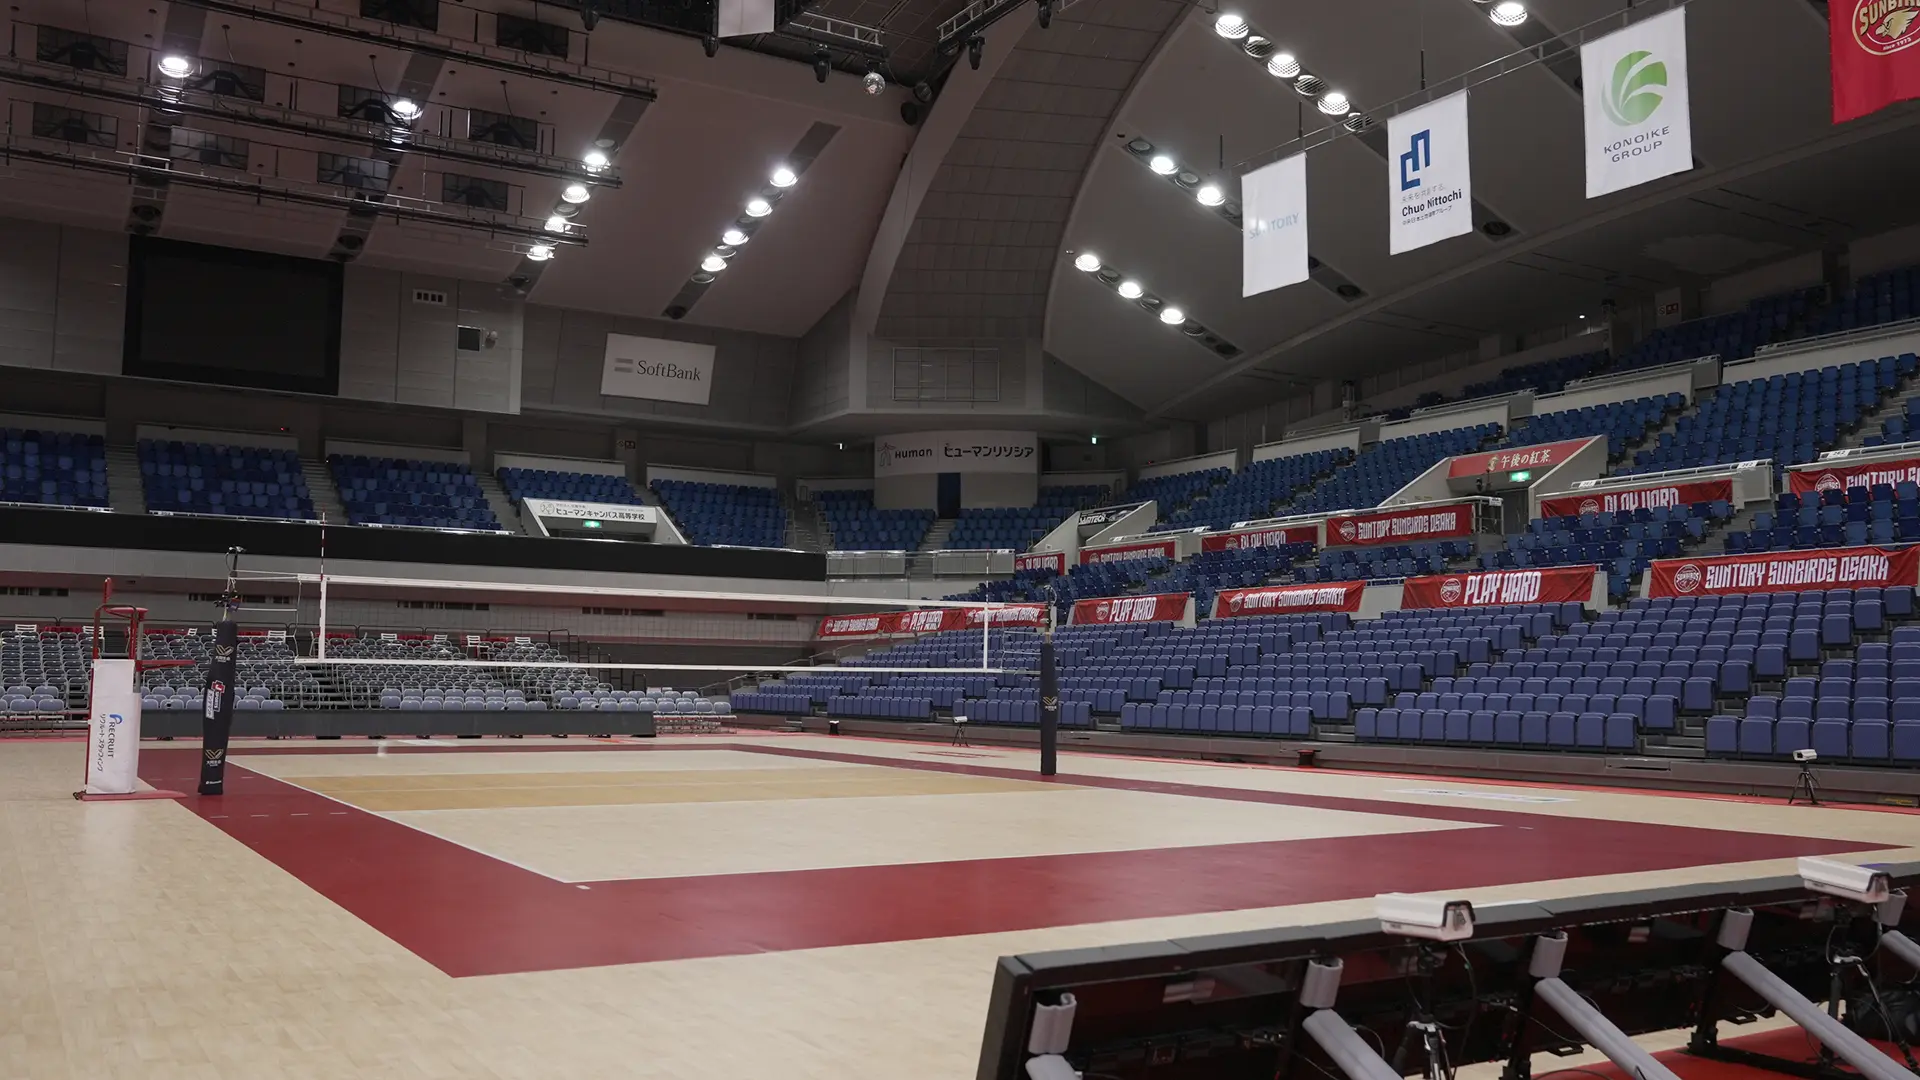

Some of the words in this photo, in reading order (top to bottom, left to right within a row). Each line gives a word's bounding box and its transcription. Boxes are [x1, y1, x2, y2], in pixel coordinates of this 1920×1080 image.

[1604, 126, 1670, 153] KONOIKE
[1611, 141, 1663, 162] GROUP
[1402, 203, 1425, 217] Chuo
[1427, 188, 1462, 209] Nittochi
[637, 360, 701, 381] SoftBank
[944, 446, 1035, 458] ヒューマンリソシア
[1501, 449, 1551, 469] 午後の紅茶
[556, 507, 645, 520] ヒューマンキャンパス高等学校
[1358, 519, 1391, 539] SUNTORY
[1392, 515, 1429, 536] SUNBIRDS
[1430, 512, 1456, 532] OSAKA
[1705, 561, 1767, 589] SUNTORY
[1767, 557, 1837, 586] SUNBIRDS
[1839, 554, 1889, 582] OSAKA
[1244, 591, 1280, 608] SUNTORY
[1278, 588, 1319, 607] SUNBIRDS
[1315, 588, 1347, 606] OSAKA
[1464, 573, 1502, 605] PLAY
[1501, 571, 1542, 602] HARD
[1110, 598, 1134, 622] PLAY
[1131, 596, 1157, 621] HARD
[108, 721, 116, 758] RECRUIT
